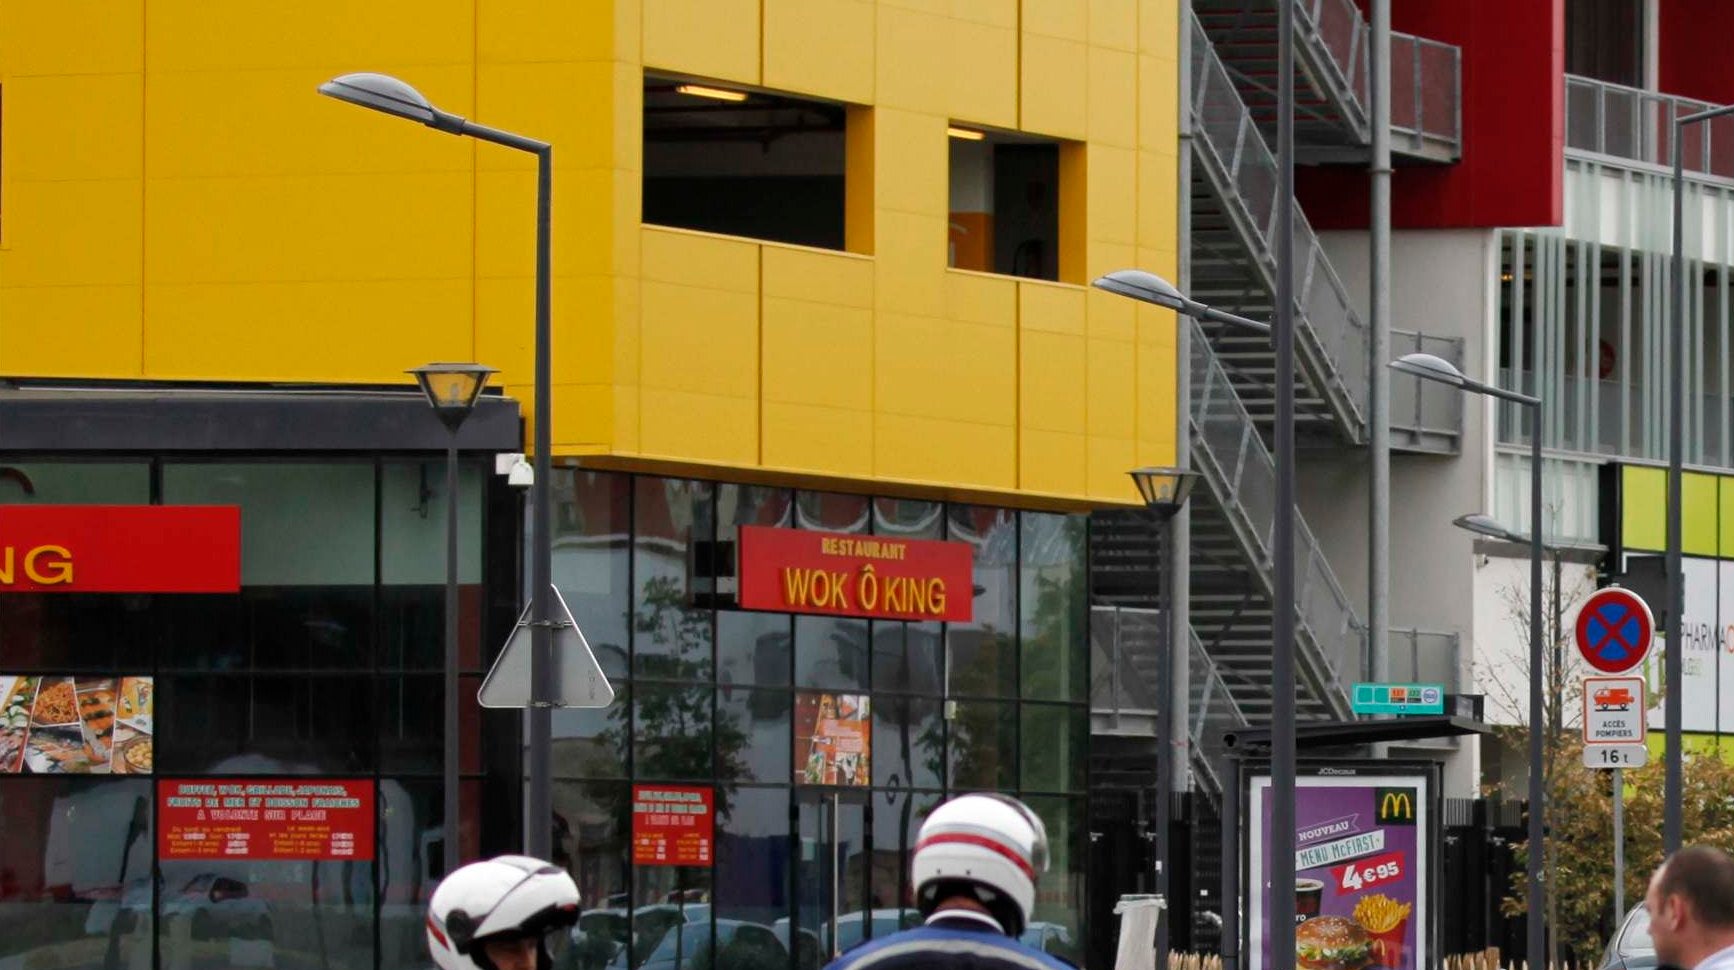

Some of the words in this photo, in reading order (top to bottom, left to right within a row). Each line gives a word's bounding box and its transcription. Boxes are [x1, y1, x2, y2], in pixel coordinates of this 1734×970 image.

[821, 537, 906, 561] RESTAURANT
[786, 566, 848, 609] WOK
[860, 563, 877, 611] Ô
[885, 575, 946, 615] KING
[1595, 729, 1633, 737] POMPIERS
[1601, 749, 1619, 763] 16
[1298, 820, 1349, 842] NOUVEAU
[1300, 845, 1330, 867] MENU
[1341, 860, 1400, 890] 4€95
